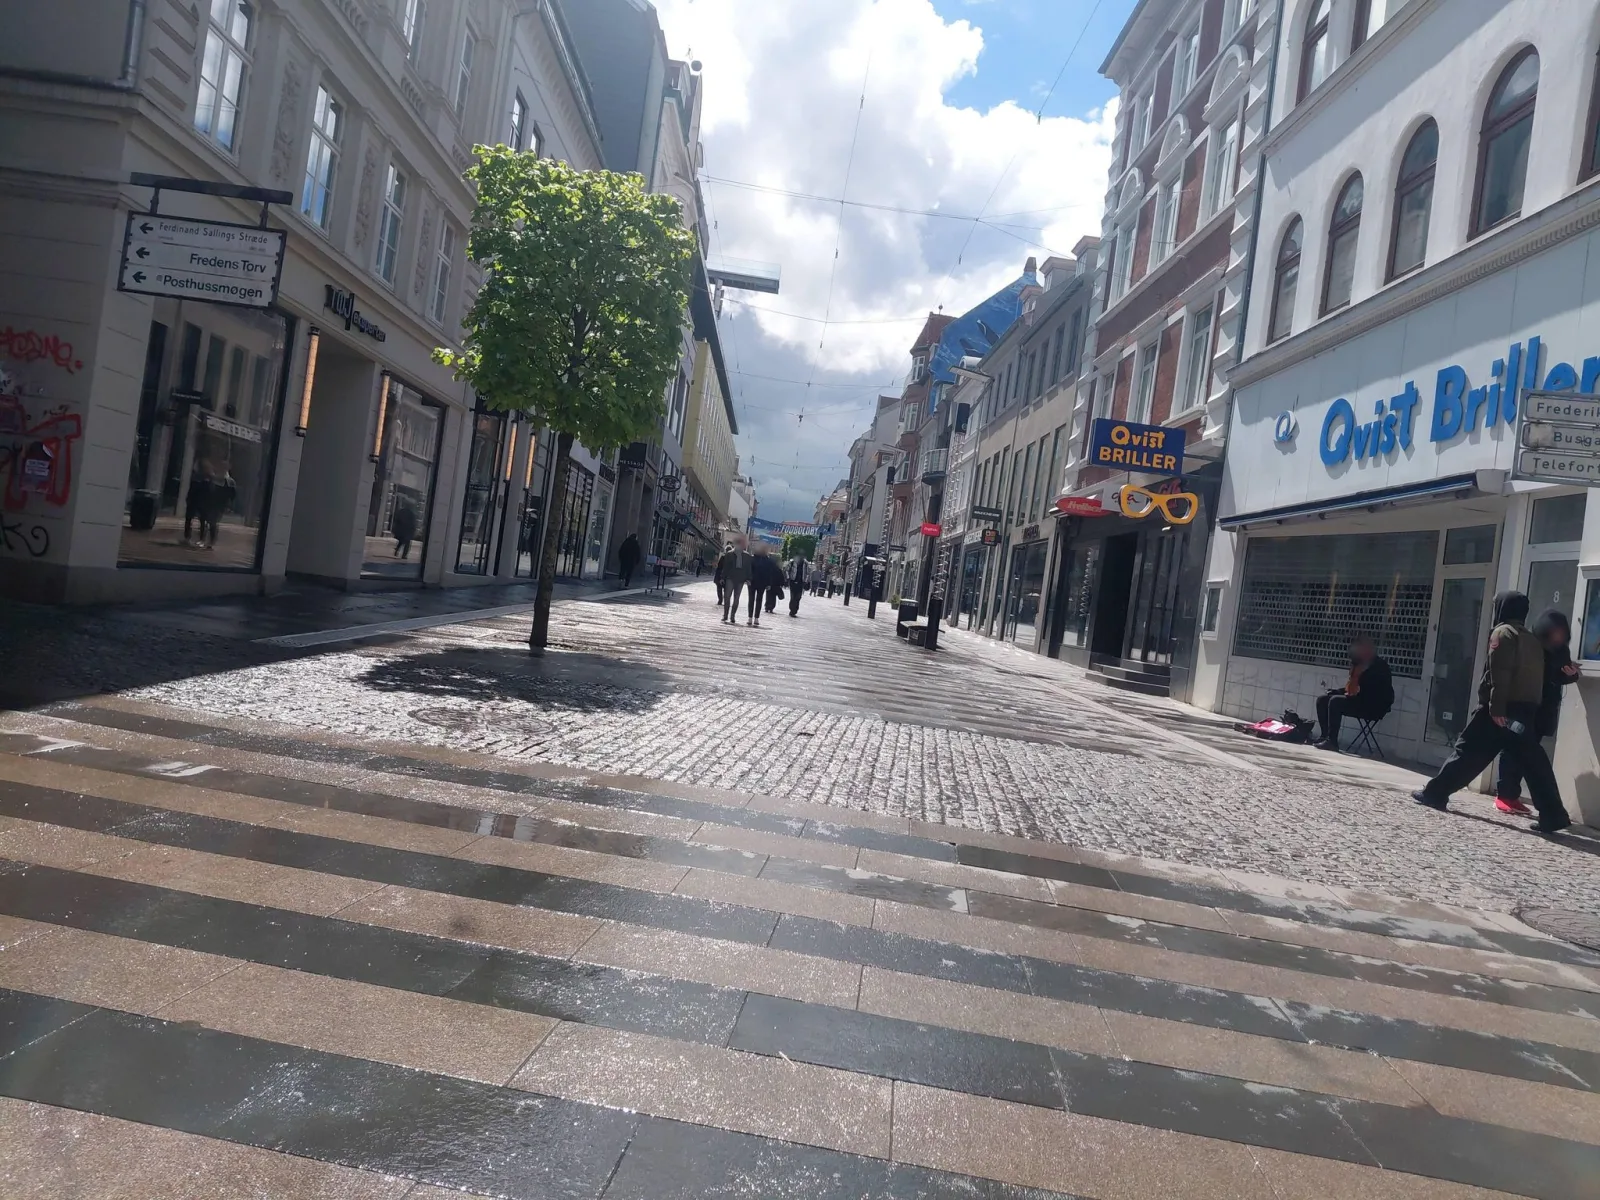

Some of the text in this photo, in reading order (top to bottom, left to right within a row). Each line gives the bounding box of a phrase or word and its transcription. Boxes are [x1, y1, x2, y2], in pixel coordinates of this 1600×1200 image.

[159, 222, 268, 244] Ferdinand Sallings Stræde
[189, 253, 267, 273] Fredens Torv
[163, 275, 263, 299] Posthussmøgen
[1319, 380, 1418, 467] Qvist
[1111, 425, 1166, 449] Qvist
[1099, 446, 1176, 471] BRILLER
[1553, 590, 1561, 603] 8
